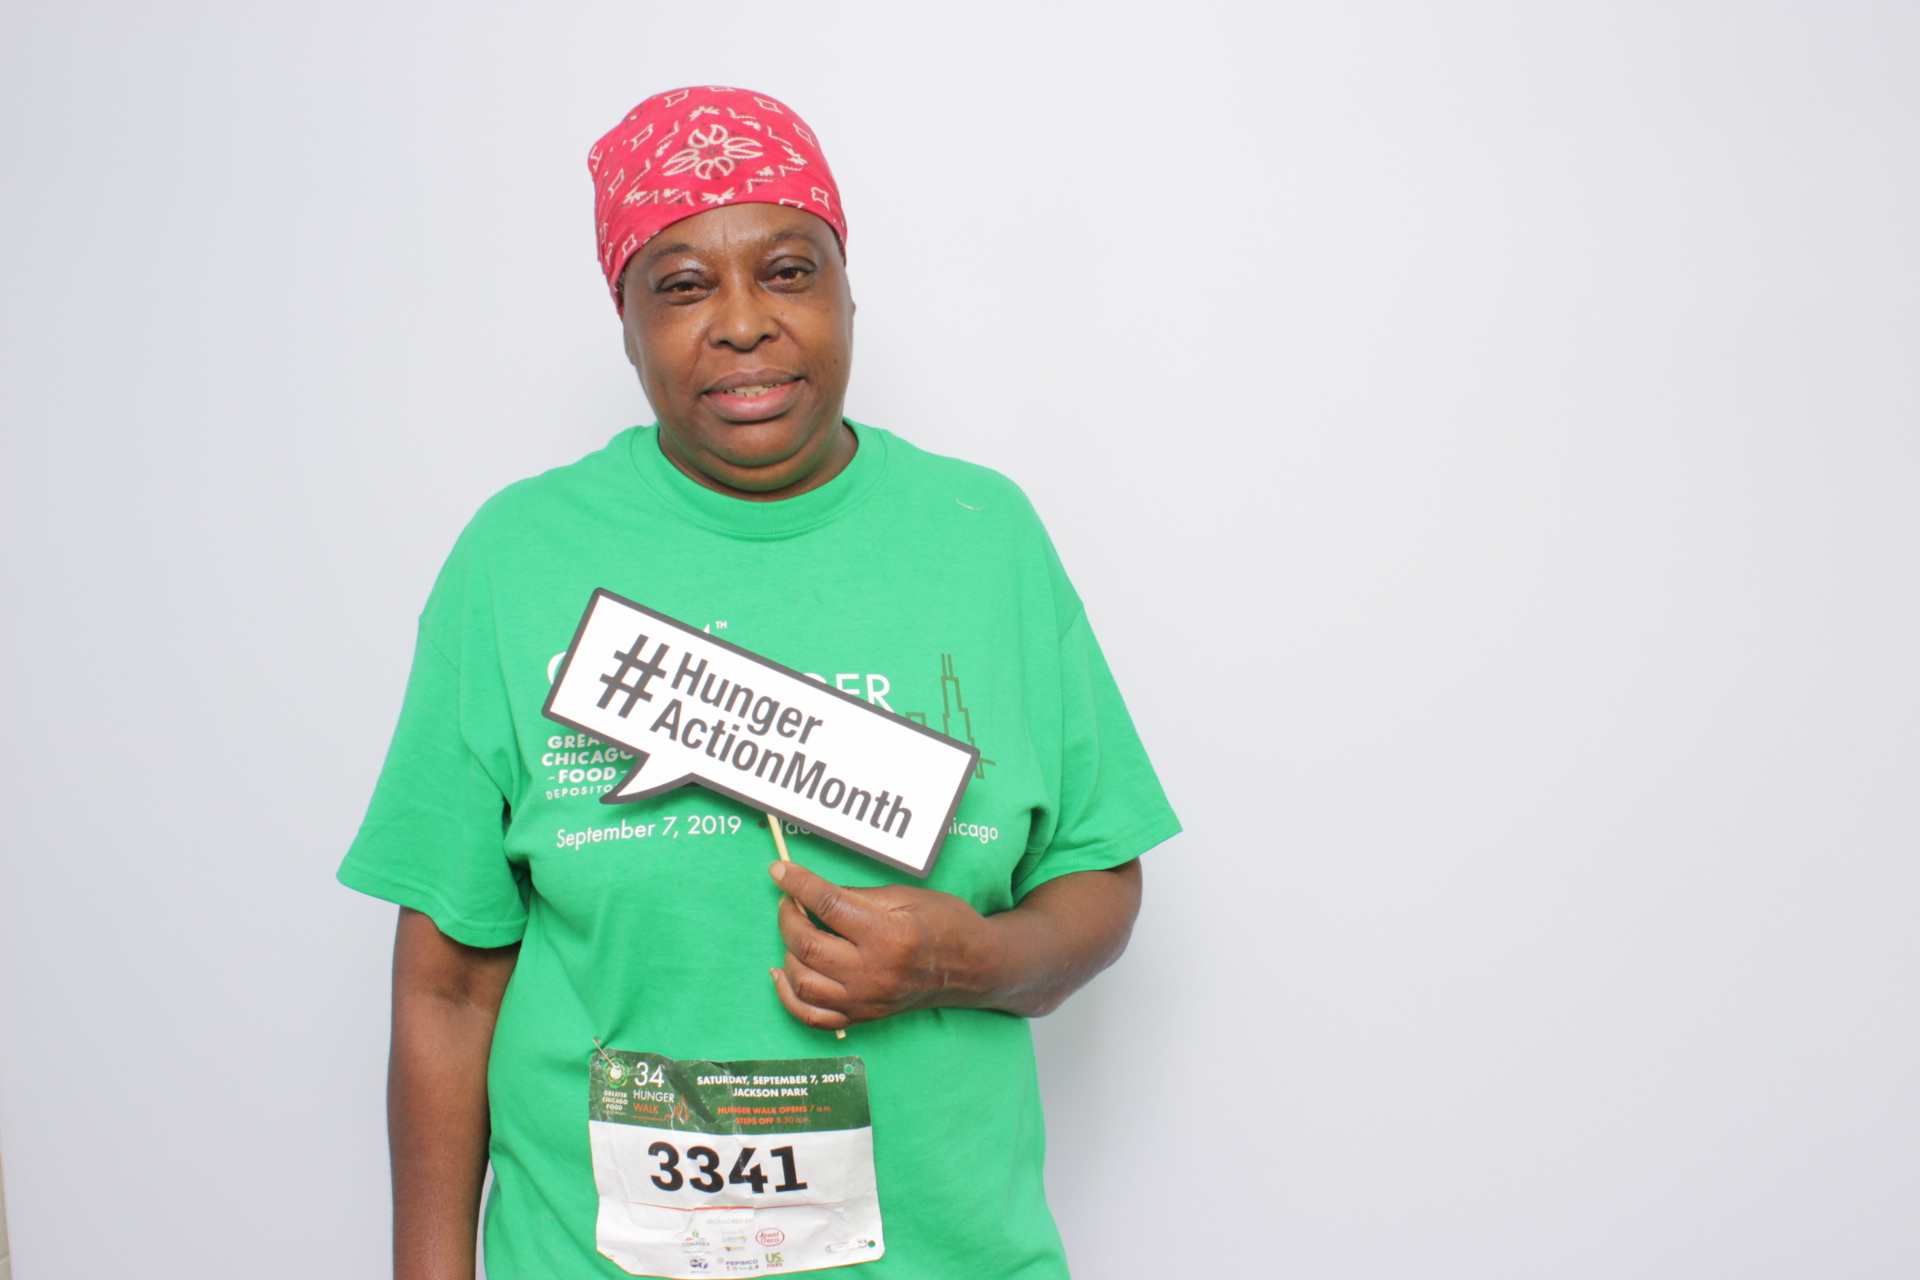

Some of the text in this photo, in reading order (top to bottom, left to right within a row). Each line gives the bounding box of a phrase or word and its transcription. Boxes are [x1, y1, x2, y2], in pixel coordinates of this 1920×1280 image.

[649, 698, 913, 839] ActionMonth
[545, 784, 617, 800] DEPOSITO
[556, 815, 742, 851] September 7, 2019
[634, 1061, 665, 1088] 34
[696, 1073, 846, 1086] SATURDAY, SEPTEMBER 7, 2019
[603, 1090, 628, 1098] GREATER
[633, 1089, 675, 1103] HUNGER
[733, 1087, 808, 1097] JACKSON PARK
[602, 1097, 628, 1105] CHICAGO
[606, 1103, 623, 1111] FOOD
[633, 1103, 660, 1115] WALK
[717, 1106, 751, 1114] HUNGER
[752, 1106, 777, 1114] WALK
[779, 1105, 808, 1114] OPENS
[735, 1117, 757, 1125] STEPS
[758, 1117, 774, 1125] OFF
[776, 1116, 794, 1124] 8:30
[648, 1141, 808, 1194] 3341
[759, 1230, 780, 1238] Jewel
